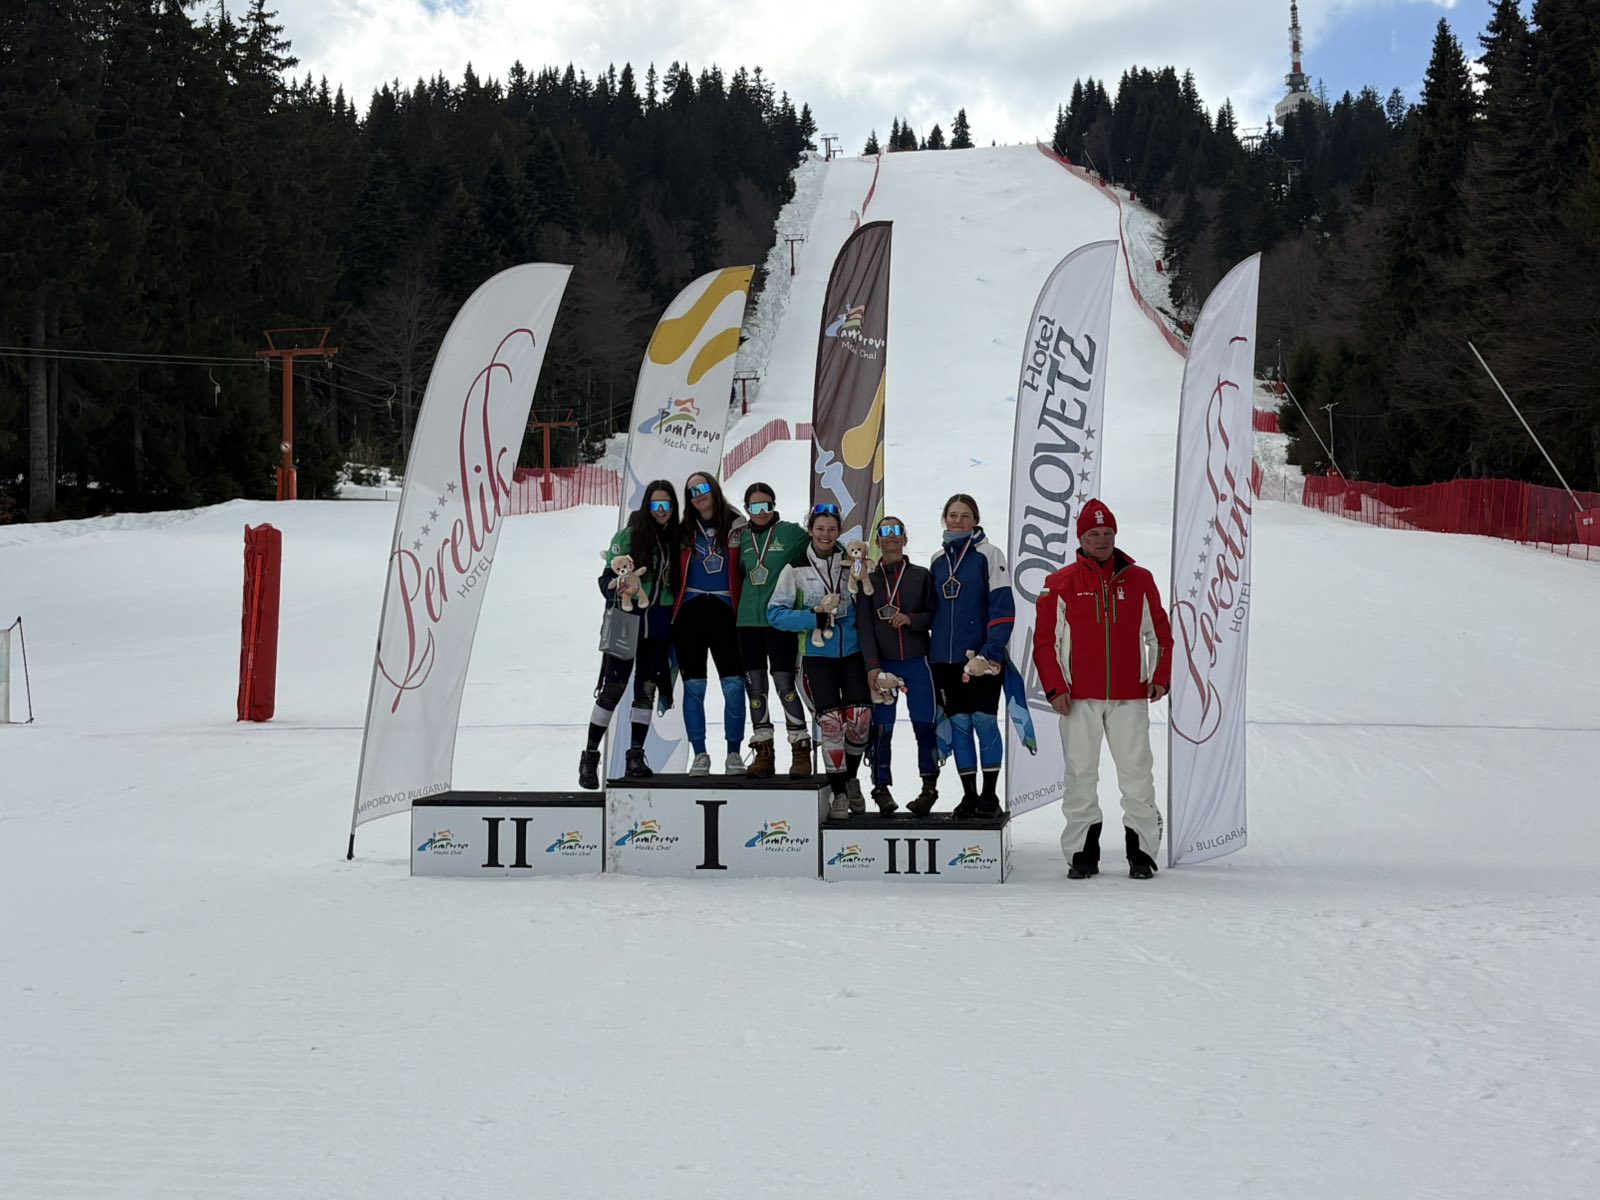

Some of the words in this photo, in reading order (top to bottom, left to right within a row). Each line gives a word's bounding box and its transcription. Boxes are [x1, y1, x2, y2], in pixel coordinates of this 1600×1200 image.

[1022, 315, 1056, 392] Hotel
[662, 437, 689, 450] Mechi
[689, 442, 710, 455] Chal
[1014, 325, 1097, 605] ORLOVETZ
[377, 328, 536, 714] Perelik
[456, 555, 495, 600] HOTEL
[407, 781, 452, 800] BULGARIA
[481, 816, 534, 869] II
[695, 799, 728, 870] I
[883, 837, 941, 875] III
[1195, 826, 1247, 852] BULGARIA
